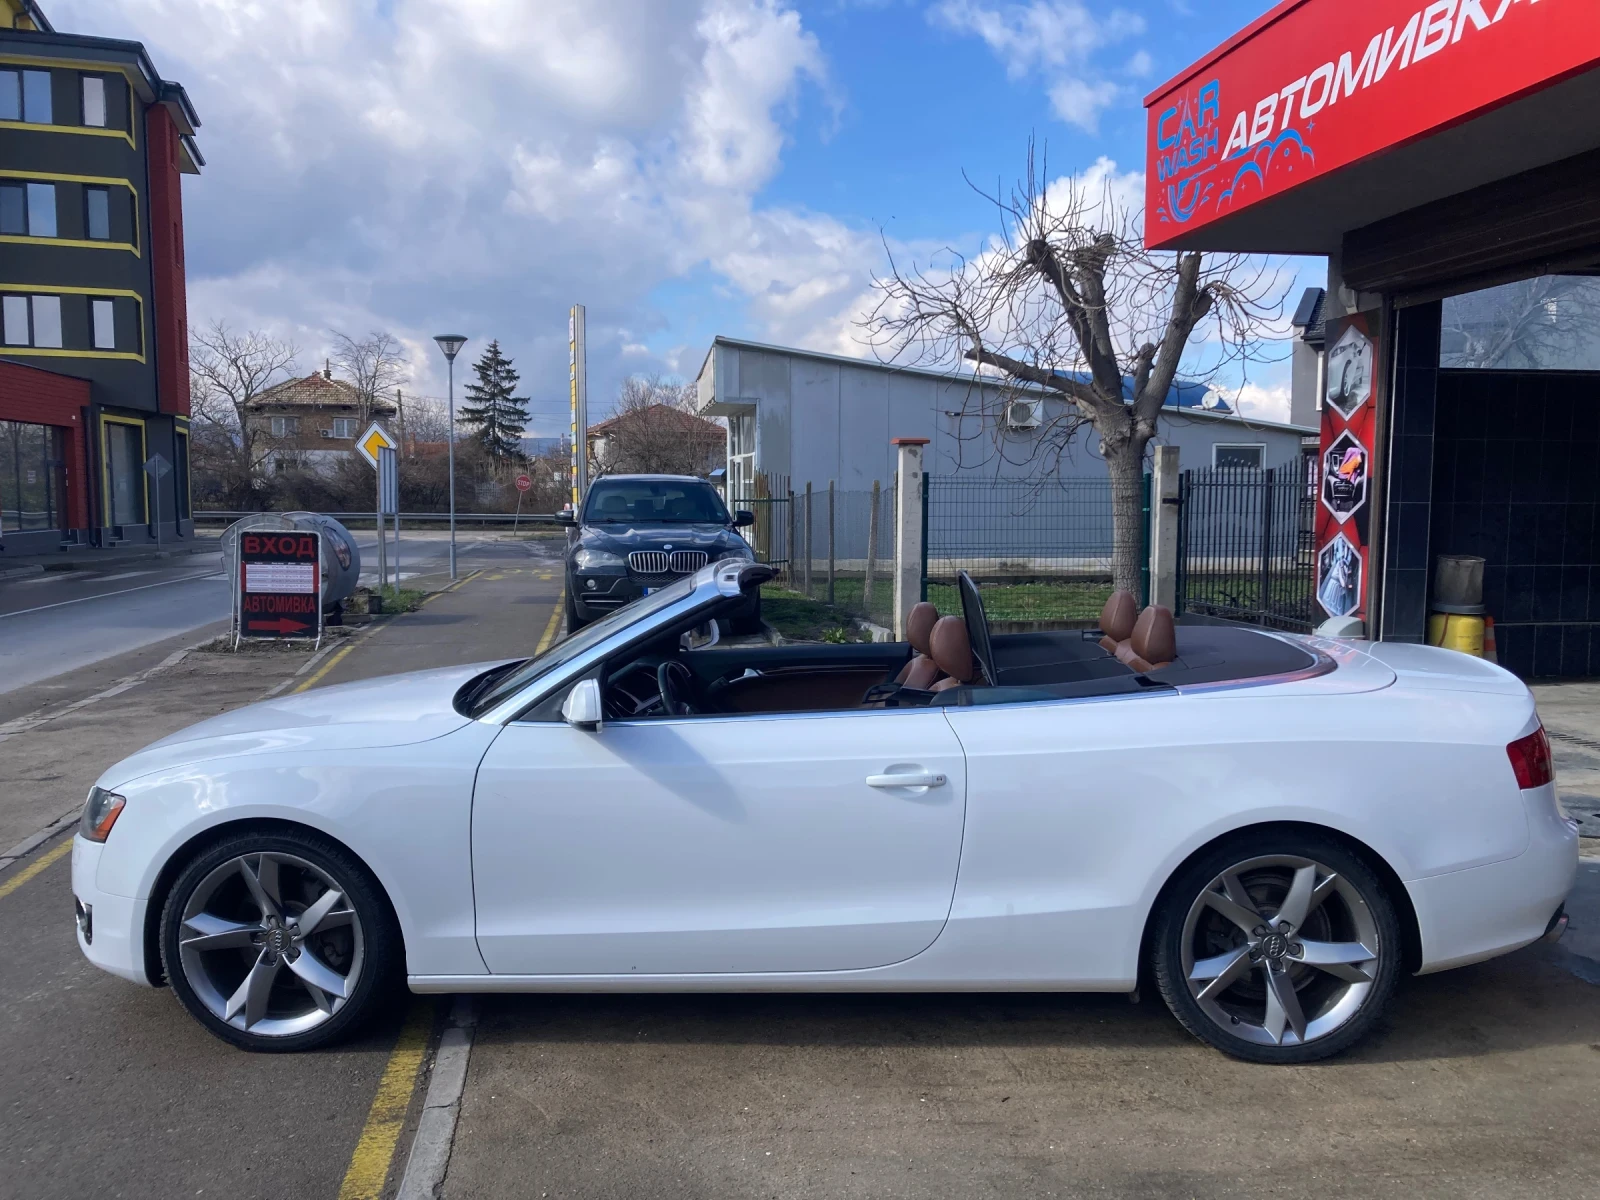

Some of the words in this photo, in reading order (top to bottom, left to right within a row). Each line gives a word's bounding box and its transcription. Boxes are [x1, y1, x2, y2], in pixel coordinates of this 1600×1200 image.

[1157, 79, 1219, 150] CAR
[1157, 127, 1218, 182] WASH
[244, 536, 315, 558] ВХОД
[243, 596, 316, 613] АВТОМИВКА
